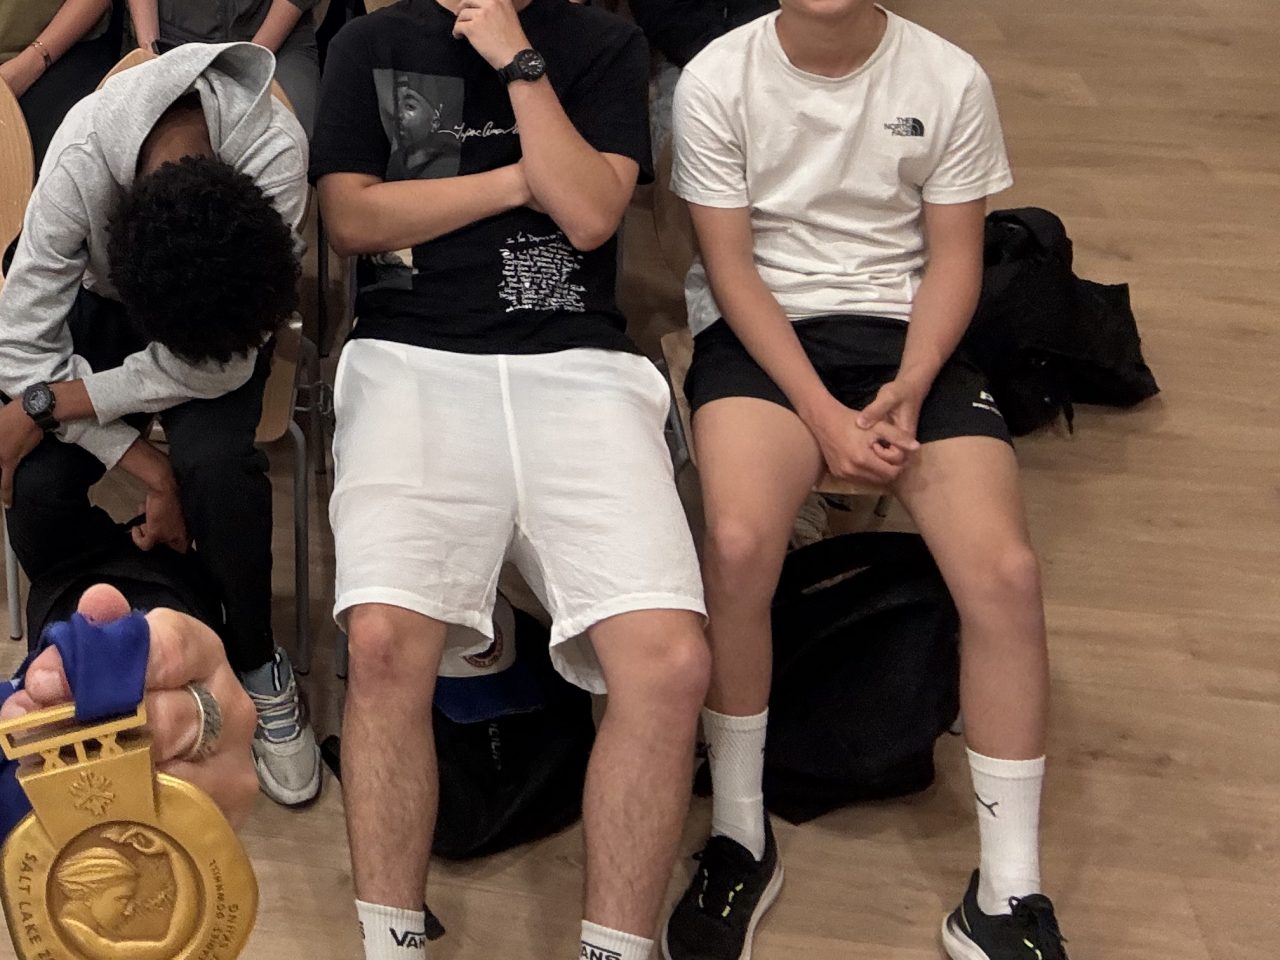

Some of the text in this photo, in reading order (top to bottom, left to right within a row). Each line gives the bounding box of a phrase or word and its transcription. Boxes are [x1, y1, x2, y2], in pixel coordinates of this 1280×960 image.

[896, 116, 911, 124] THE
[891, 129, 912, 137] FACE
[18, 852, 38, 895] SALT
[18, 901, 42, 945] LAKE
